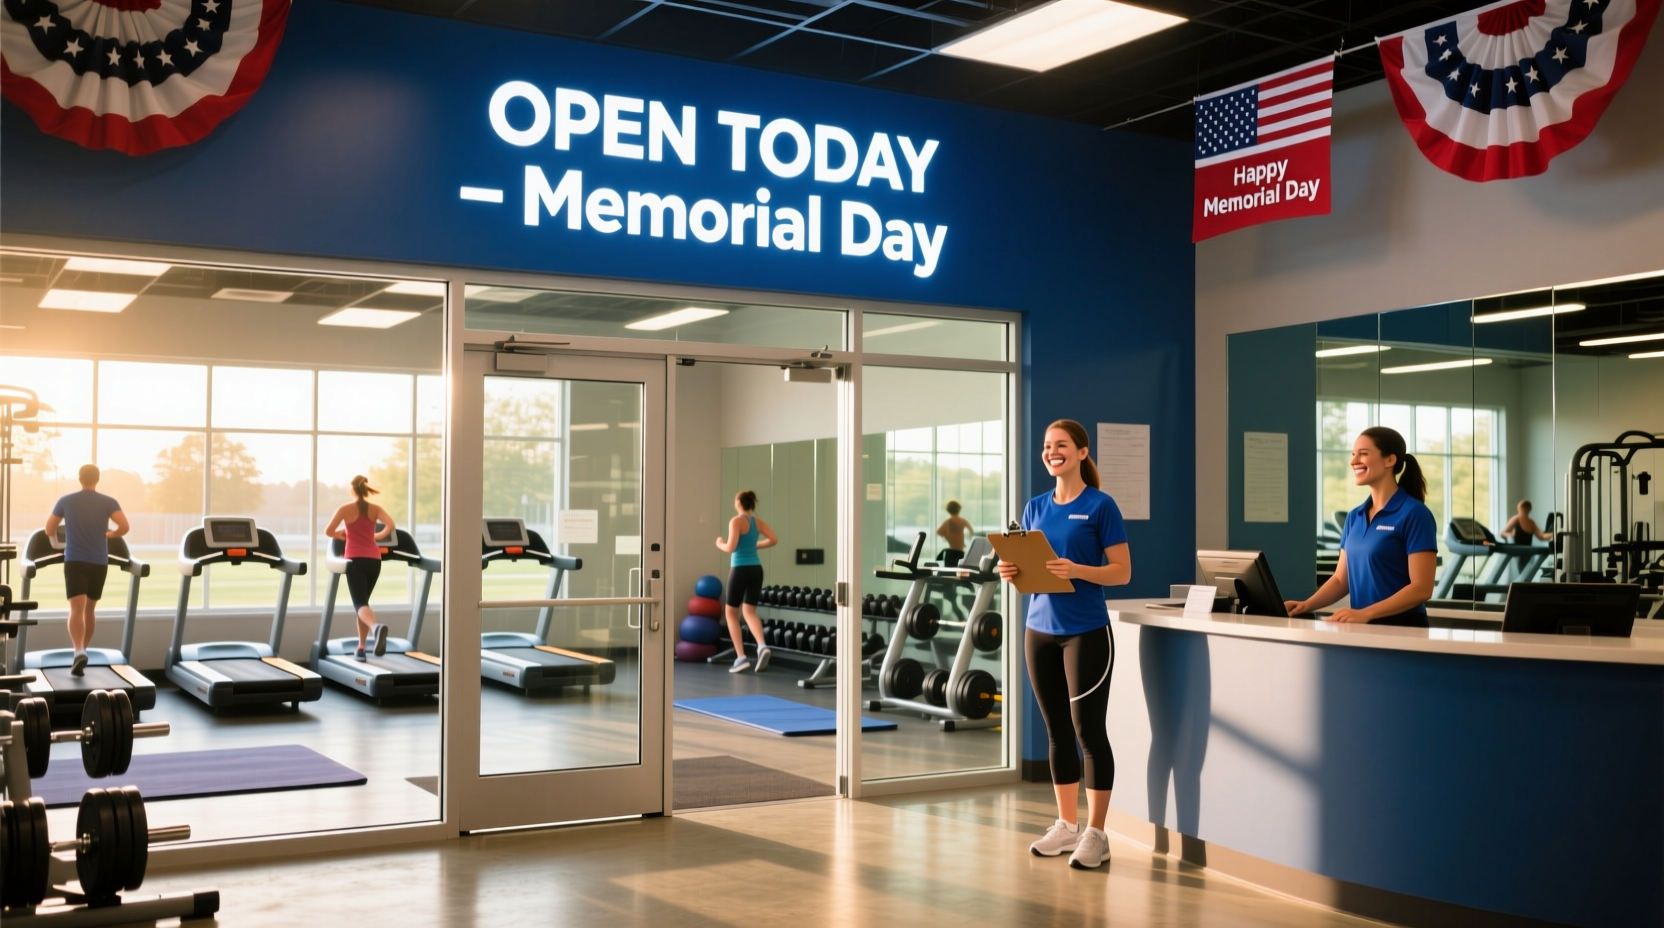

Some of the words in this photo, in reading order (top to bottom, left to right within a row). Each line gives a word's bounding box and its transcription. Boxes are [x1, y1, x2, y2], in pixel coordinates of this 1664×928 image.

[488, 80, 696, 166] OPEN
[717, 110, 940, 193] TODAY
[1233, 158, 1289, 186] Happy
[524, 165, 821, 253] Memorial
[841, 200, 948, 279] Day
[1203, 183, 1281, 218] Memorial
[1285, 178, 1321, 202] Day
